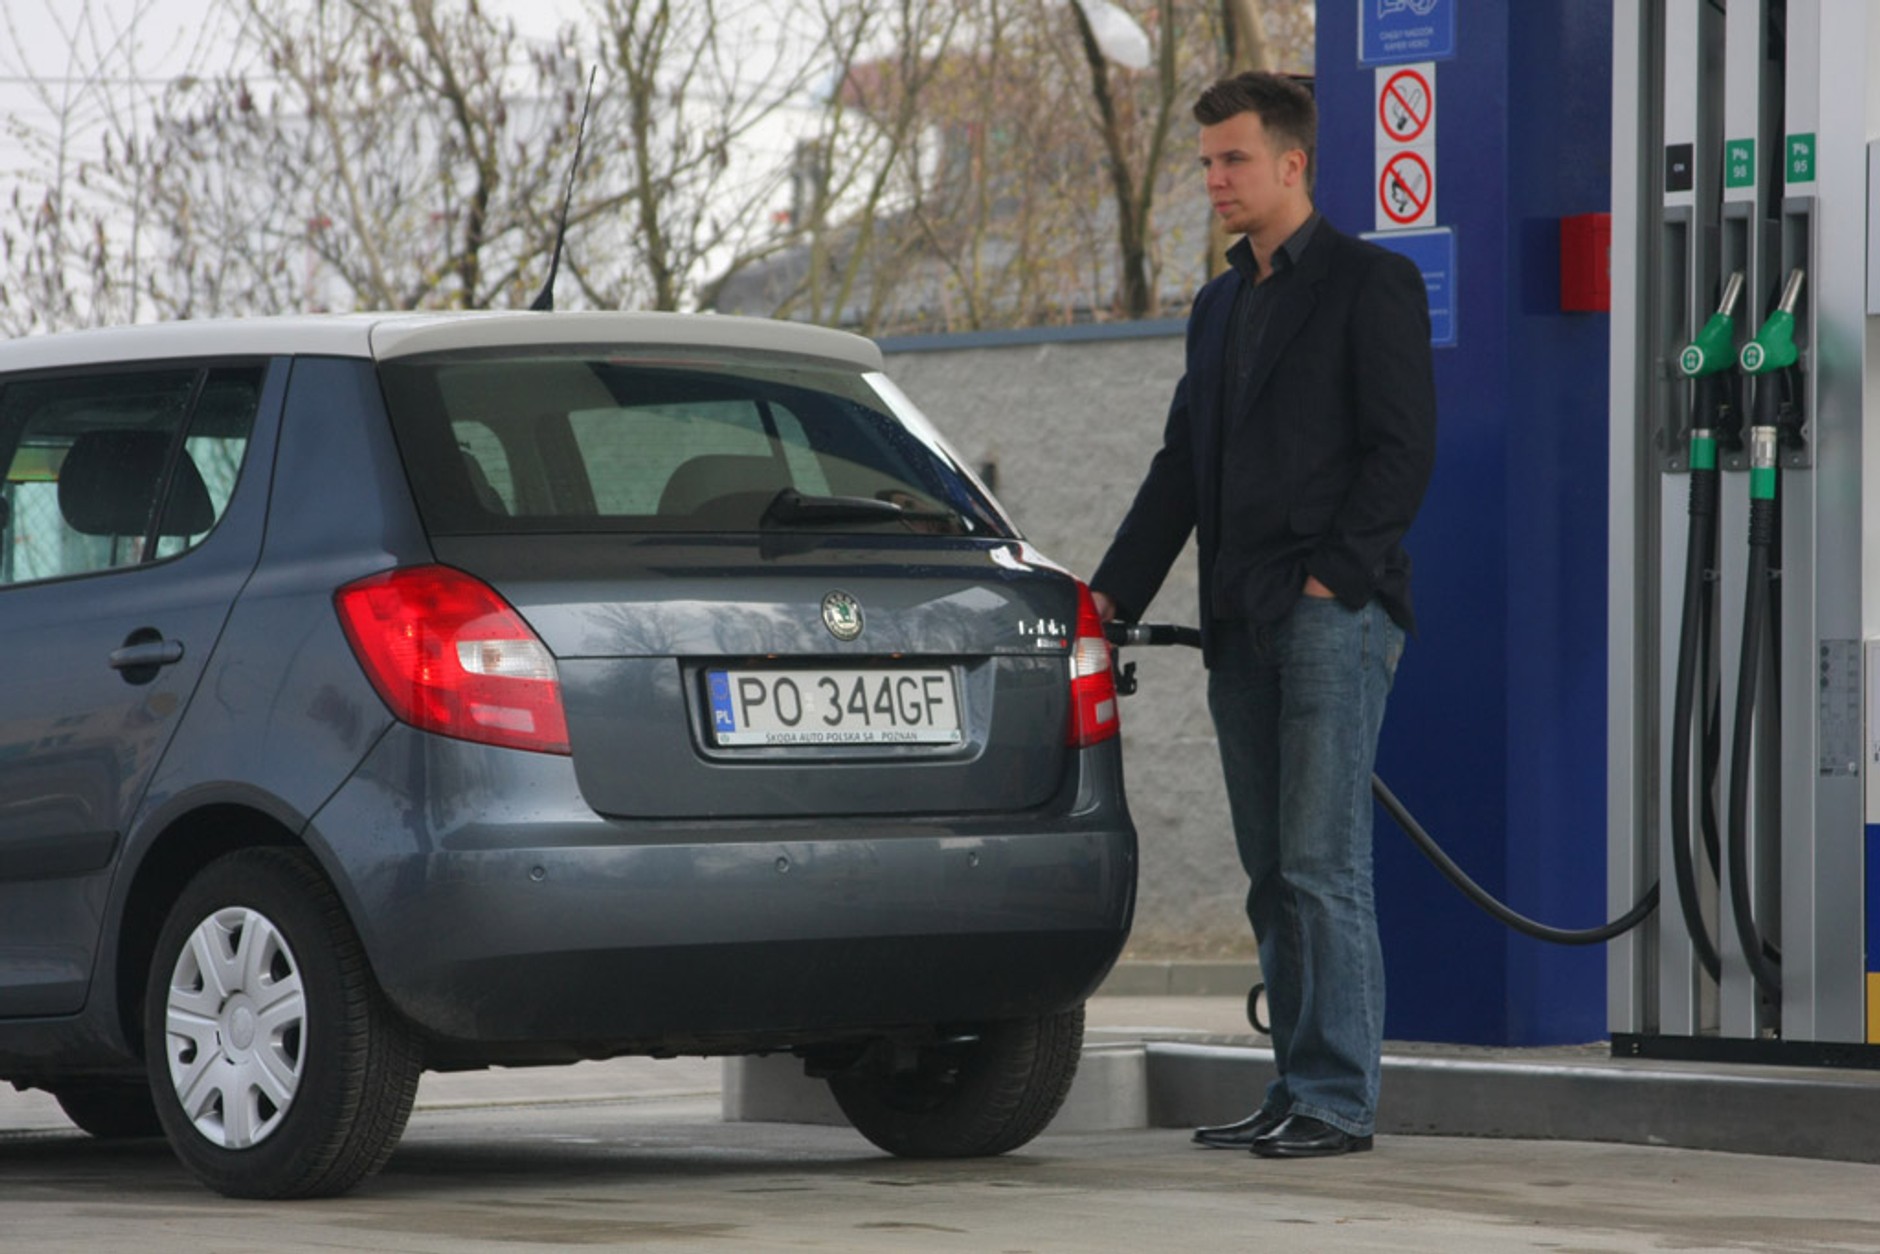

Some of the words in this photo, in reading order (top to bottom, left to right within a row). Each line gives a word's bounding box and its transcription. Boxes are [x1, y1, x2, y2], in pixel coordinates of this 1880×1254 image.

[1794, 160, 1807, 173] 95
[738, 677, 802, 728] PO
[817, 676, 944, 726] 344GF
[716, 710, 732, 724] PL
[800, 732, 824, 742] AUTO
[826, 732, 860, 742] POLSKA
